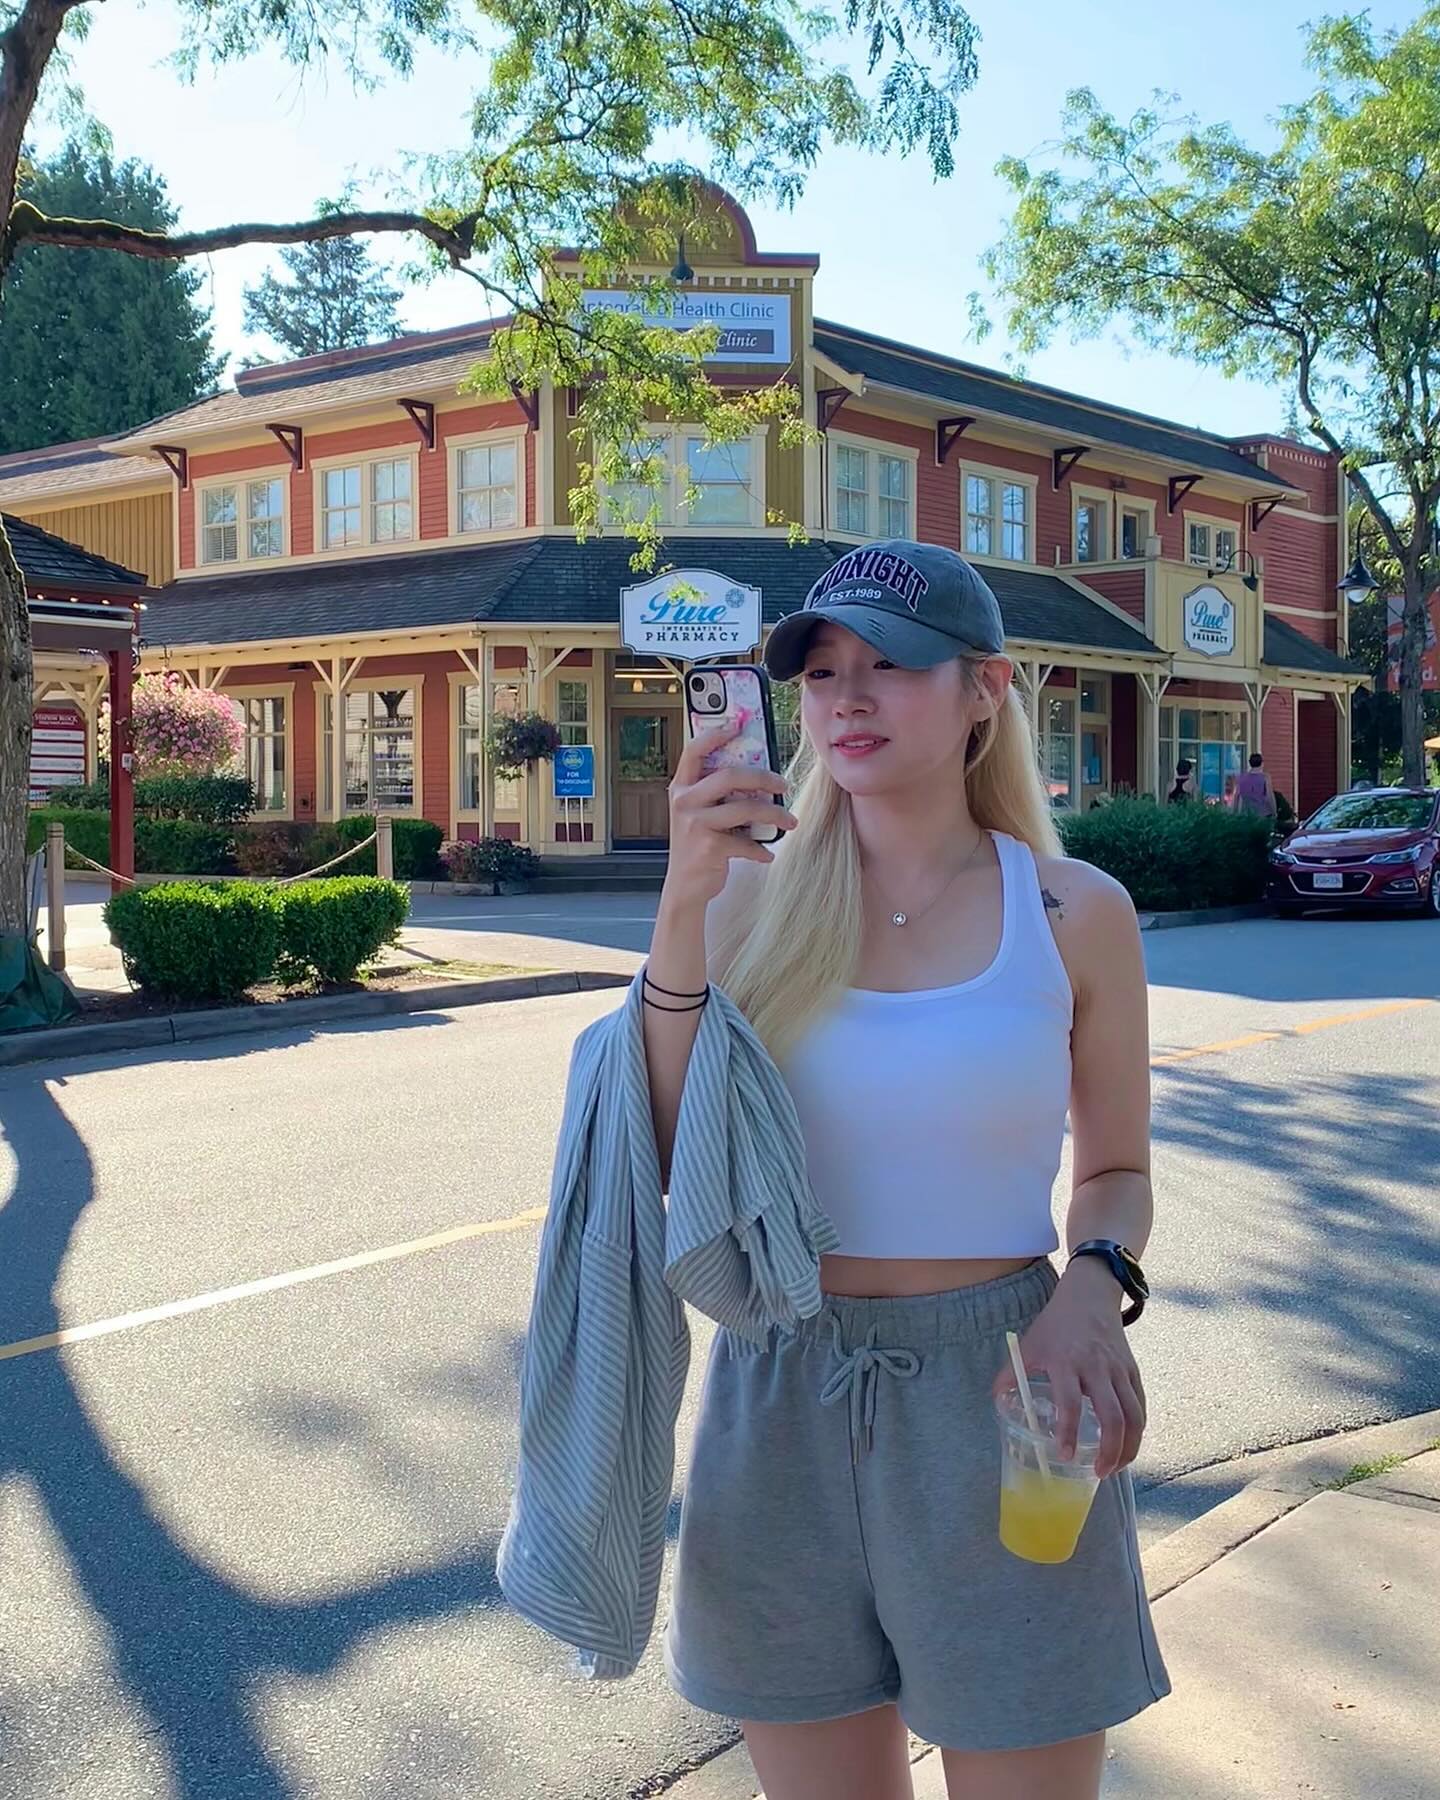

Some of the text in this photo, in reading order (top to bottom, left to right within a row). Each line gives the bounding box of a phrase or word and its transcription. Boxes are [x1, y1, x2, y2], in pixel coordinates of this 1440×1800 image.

[673, 301, 726, 317] Health
[730, 301, 774, 318] Clinic
[717, 331, 758, 347] Clinic
[829, 588, 882, 602] EST.1989
[640, 591, 728, 624] Pure
[645, 631, 740, 642] PHARMACY
